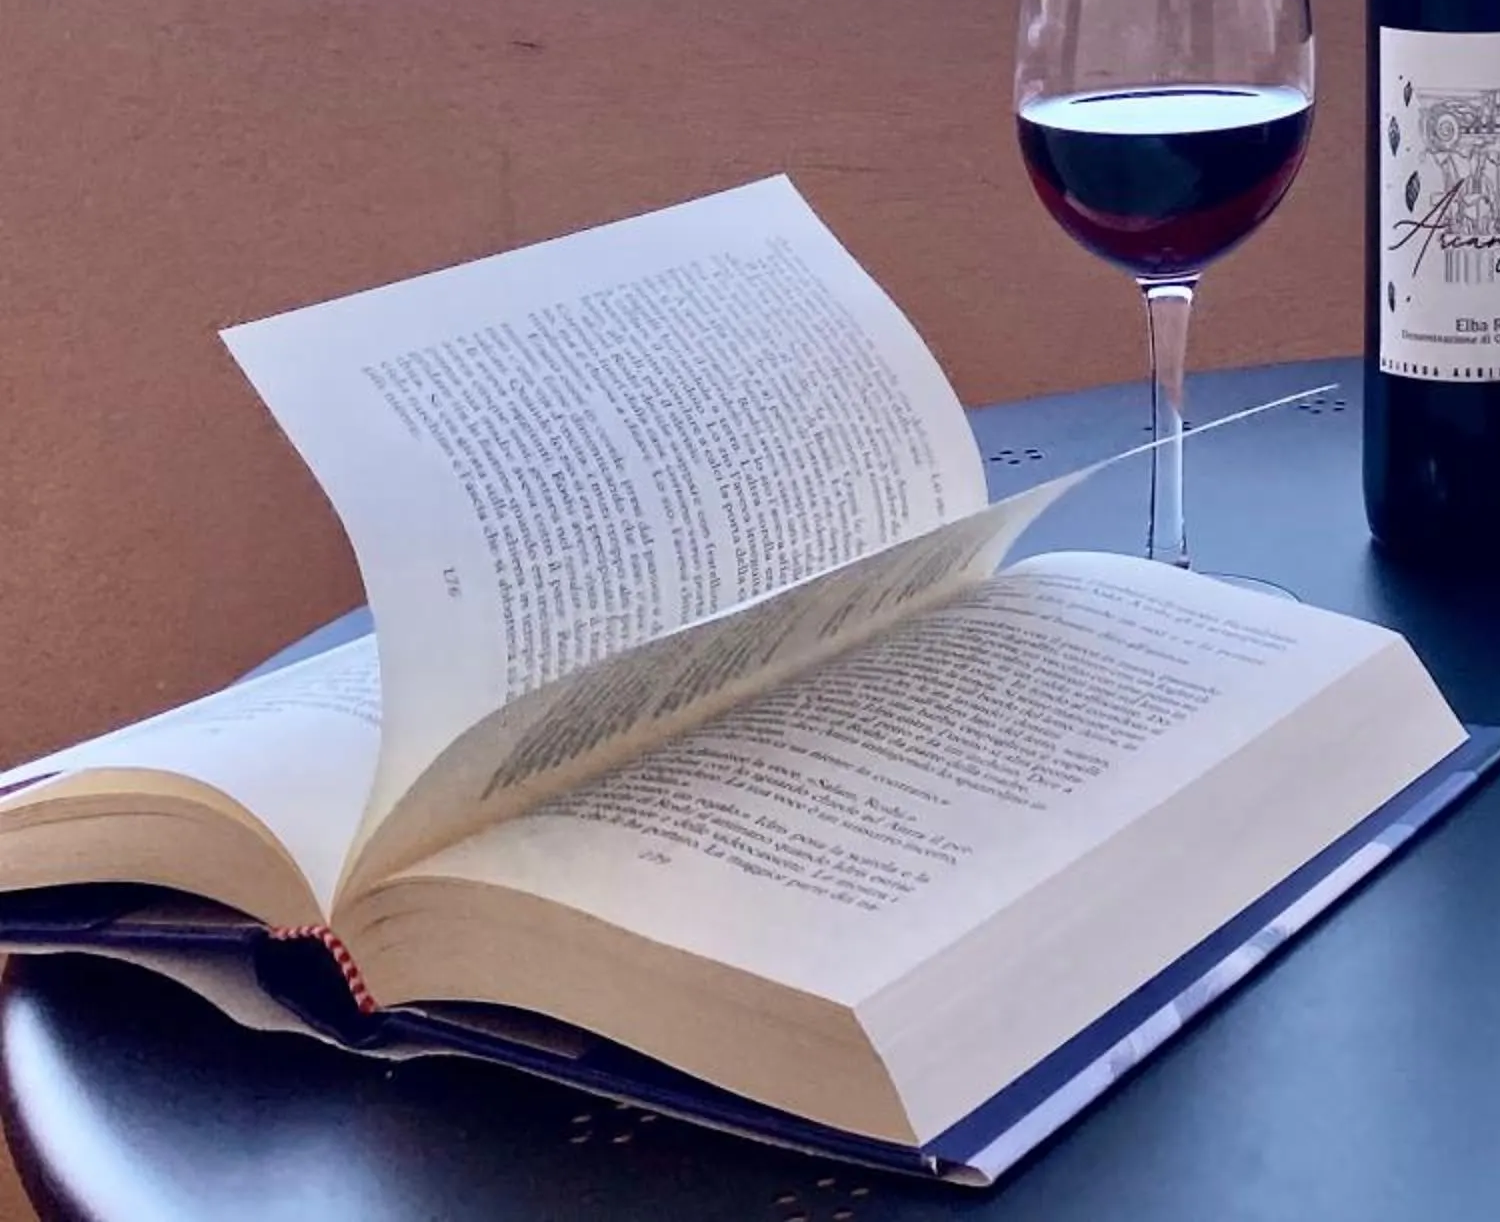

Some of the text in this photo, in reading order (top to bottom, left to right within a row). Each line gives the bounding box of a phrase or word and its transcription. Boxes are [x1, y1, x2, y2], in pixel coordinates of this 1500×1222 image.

[1455, 318, 1488, 332] Elba
[1480, 333, 1490, 344] di
[443, 565, 461, 599] 176
[637, 850, 672, 866] 179
